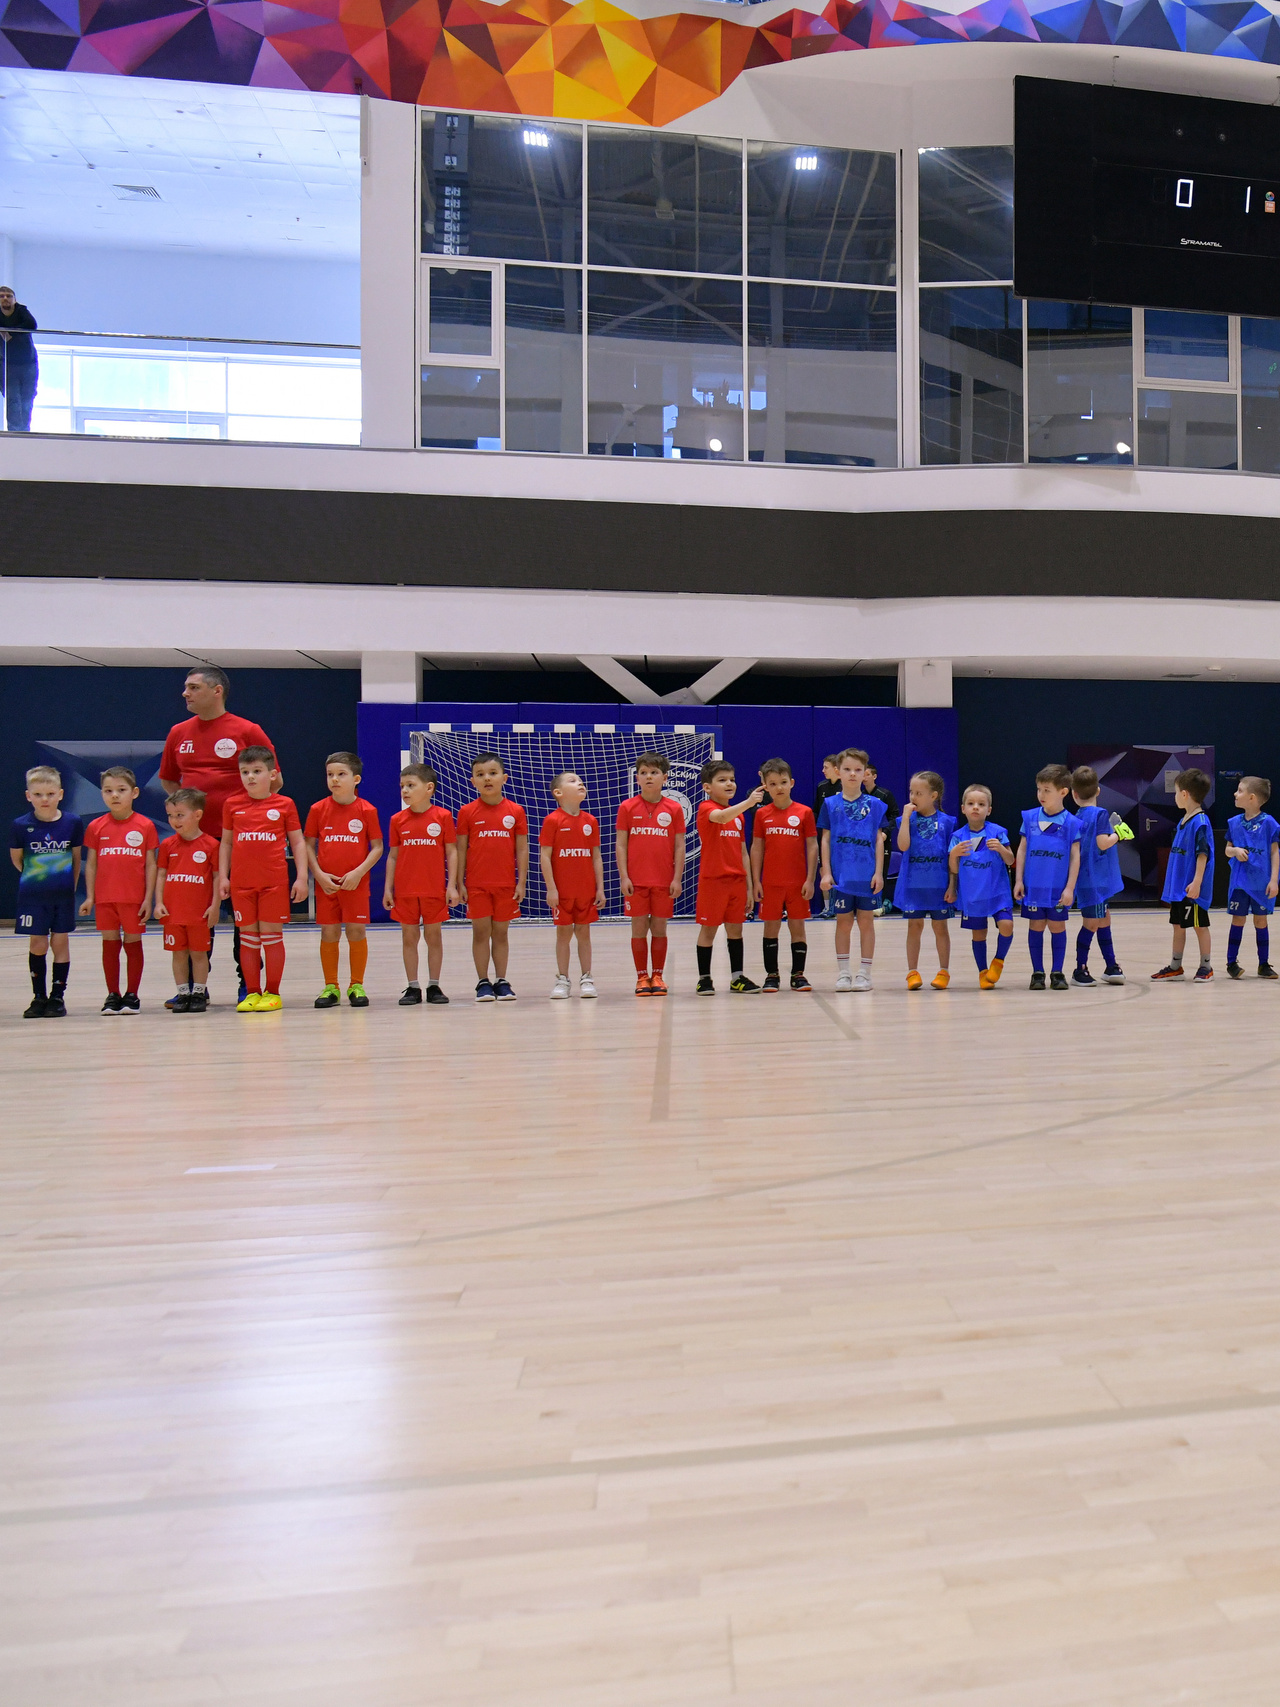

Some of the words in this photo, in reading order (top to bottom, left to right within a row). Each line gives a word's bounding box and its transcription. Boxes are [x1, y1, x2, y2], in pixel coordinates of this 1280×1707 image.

[1176, 179, 1194, 207] 0
[663, 780, 687, 788] КЕЛЬ
[630, 826, 669, 837] АРКТИКА
[720, 829, 741, 838] АРКТИ
[765, 826, 800, 837] АРКТИКА
[237, 832, 277, 842] АРКТИКА
[324, 834, 359, 843] АРКТИКА
[403, 838, 437, 846] АРКТИКА
[100, 846, 143, 857] АРКТИКА
[559, 848, 591, 857] АРКТИК
[167, 873, 205, 884] АРКТИКА
[835, 899, 846, 909] 41
[1230, 901, 1240, 911] 27
[1184, 906, 1192, 920] 7
[20, 914, 33, 927] 10
